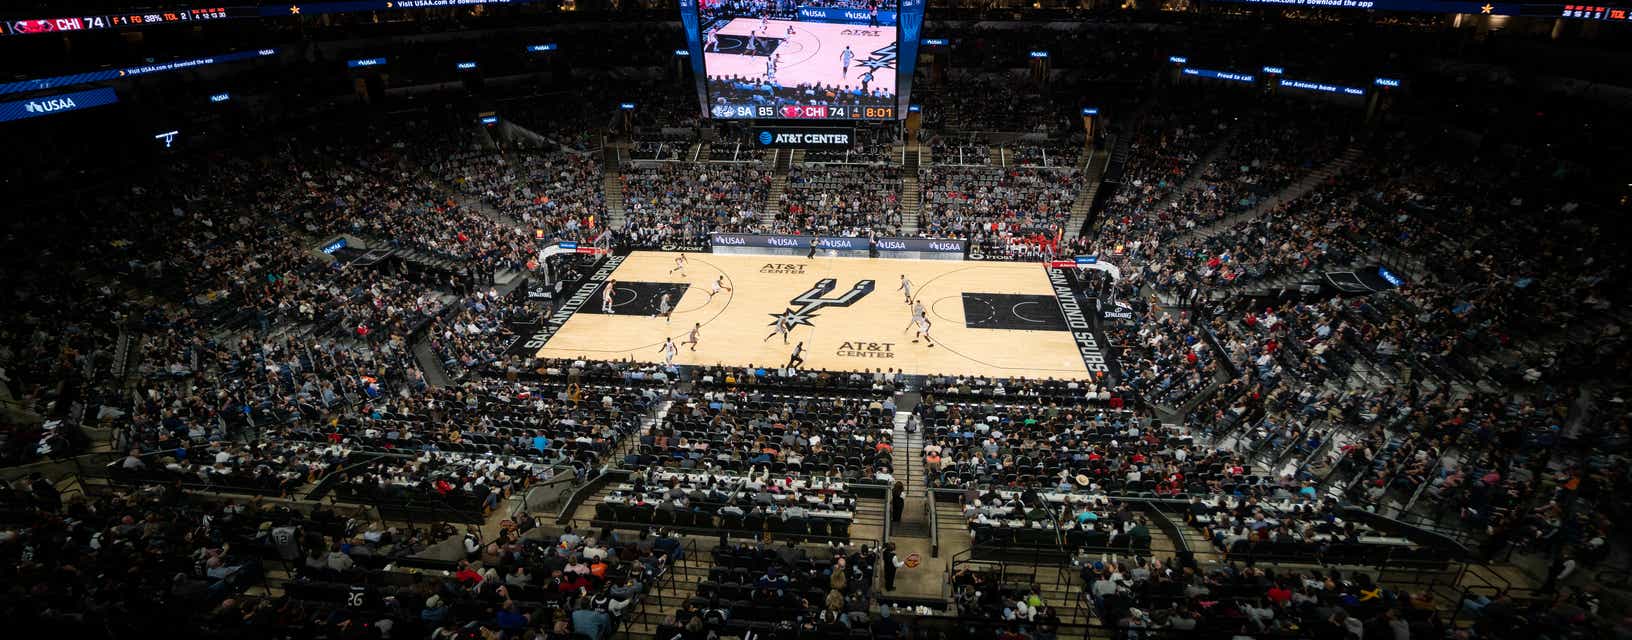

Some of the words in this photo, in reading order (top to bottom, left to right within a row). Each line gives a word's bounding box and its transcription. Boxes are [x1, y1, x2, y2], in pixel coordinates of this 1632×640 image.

[56, 18, 80, 30] CHI
[84, 17, 104, 29] 74
[144, 15, 162, 23] 38%
[180, 12, 187, 20] 2
[853, 12, 871, 20] USAA
[1293, 82, 1318, 90] Antonio
[43, 97, 76, 112] USAA
[738, 106, 752, 117] SA
[759, 107, 773, 116] 85
[806, 107, 824, 117] CHI
[830, 107, 845, 117] 74
[866, 107, 892, 118] 8:01
[775, 134, 802, 144] AT&T
[804, 134, 848, 144] CENTER
[725, 237, 745, 245] USAA
[777, 238, 798, 246] USAA
[831, 240, 851, 248] USAA
[885, 241, 906, 249] USAA
[939, 242, 960, 251] USAA
[1051, 268, 1066, 285] SAN
[548, 281, 600, 325] ANTONIO
[590, 255, 625, 281] SPURS
[1054, 285, 1088, 329] ANTONIO
[1104, 311, 1132, 319] SPALDING
[839, 341, 896, 351] AT&T
[836, 351, 895, 359] CENTER
[1074, 331, 1109, 373] SPURS
[347, 592, 364, 606] 26
